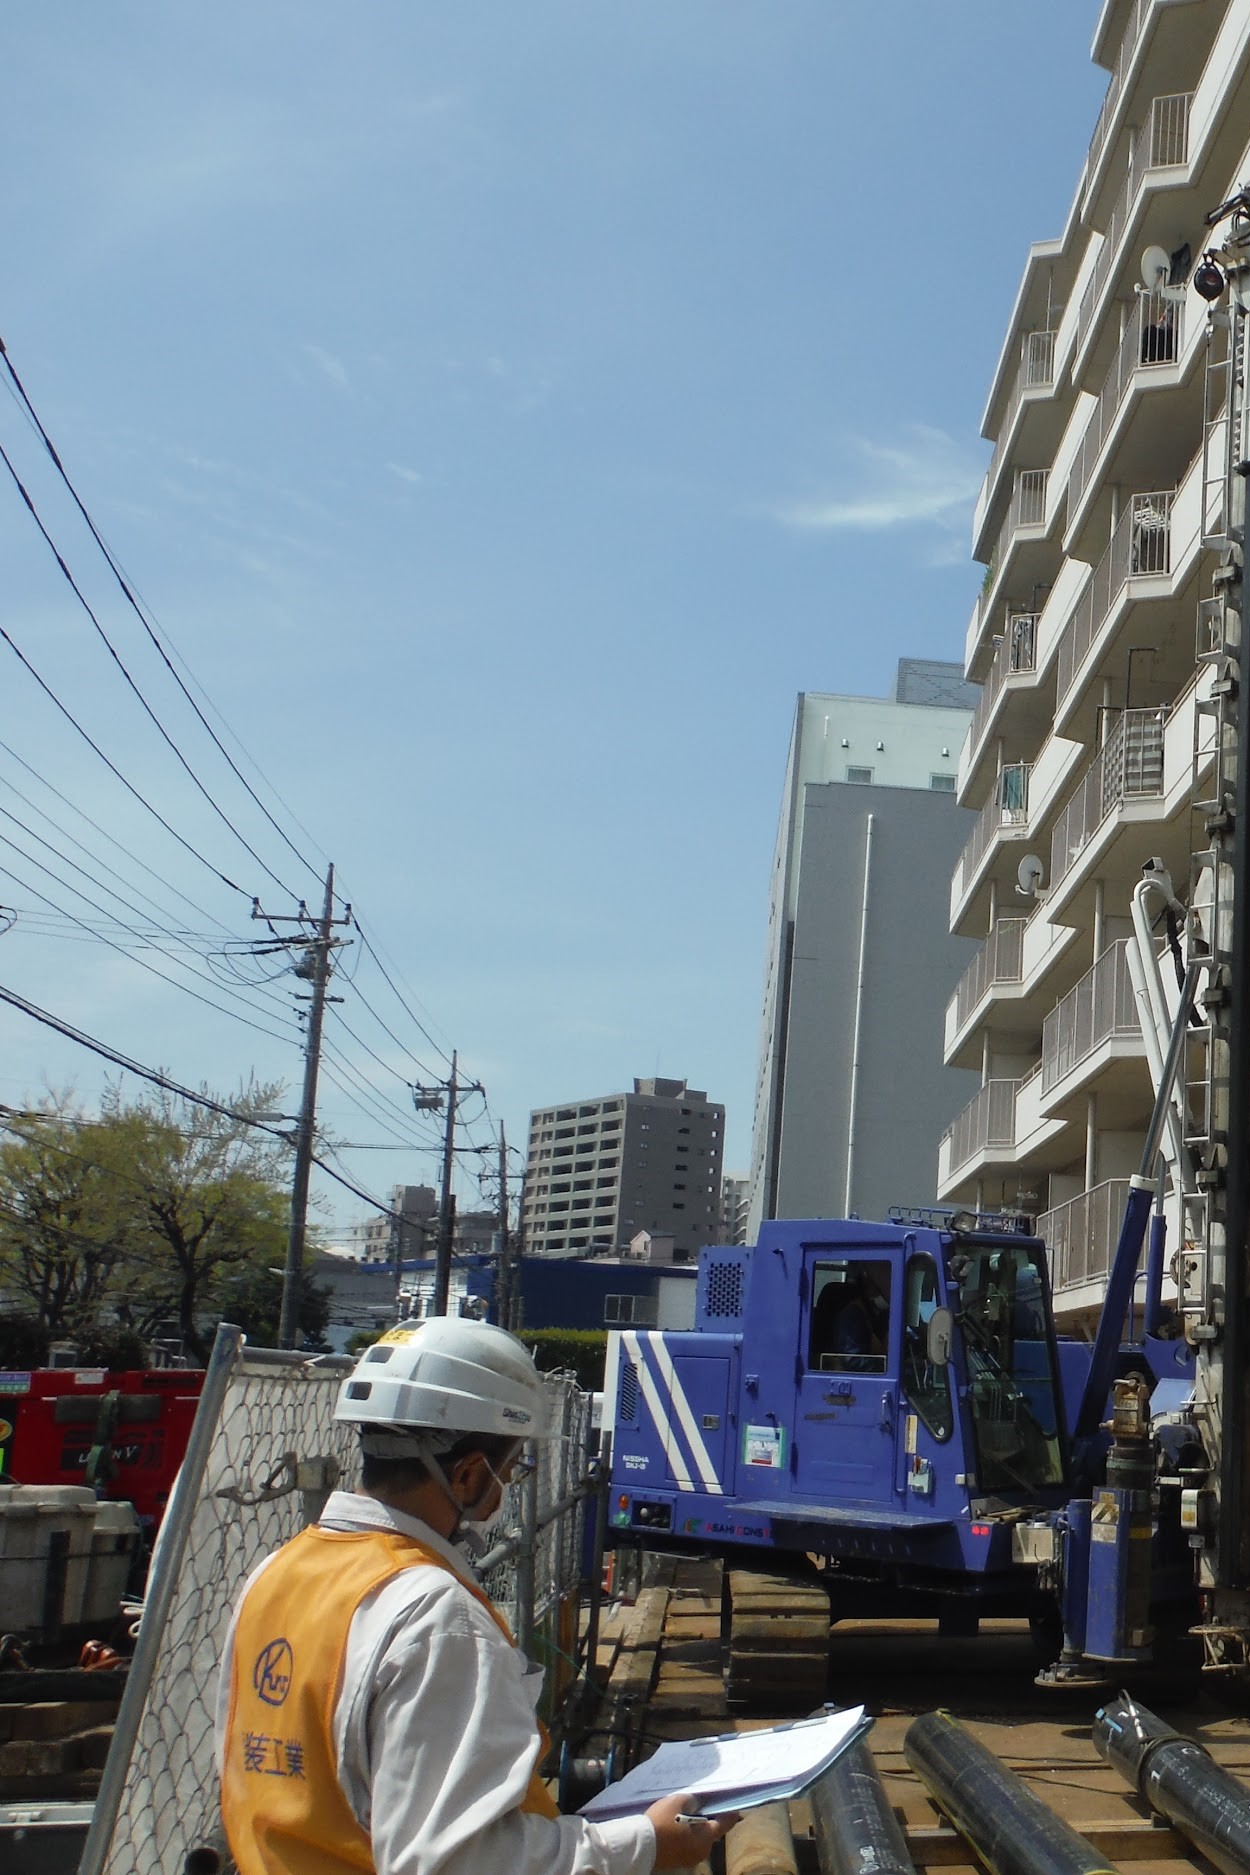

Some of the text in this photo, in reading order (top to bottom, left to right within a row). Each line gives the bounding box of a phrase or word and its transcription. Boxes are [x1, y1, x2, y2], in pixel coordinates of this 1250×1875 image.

[705, 1522, 735, 1535] ASAHI
[243, 1731, 305, 1780] 装工業
